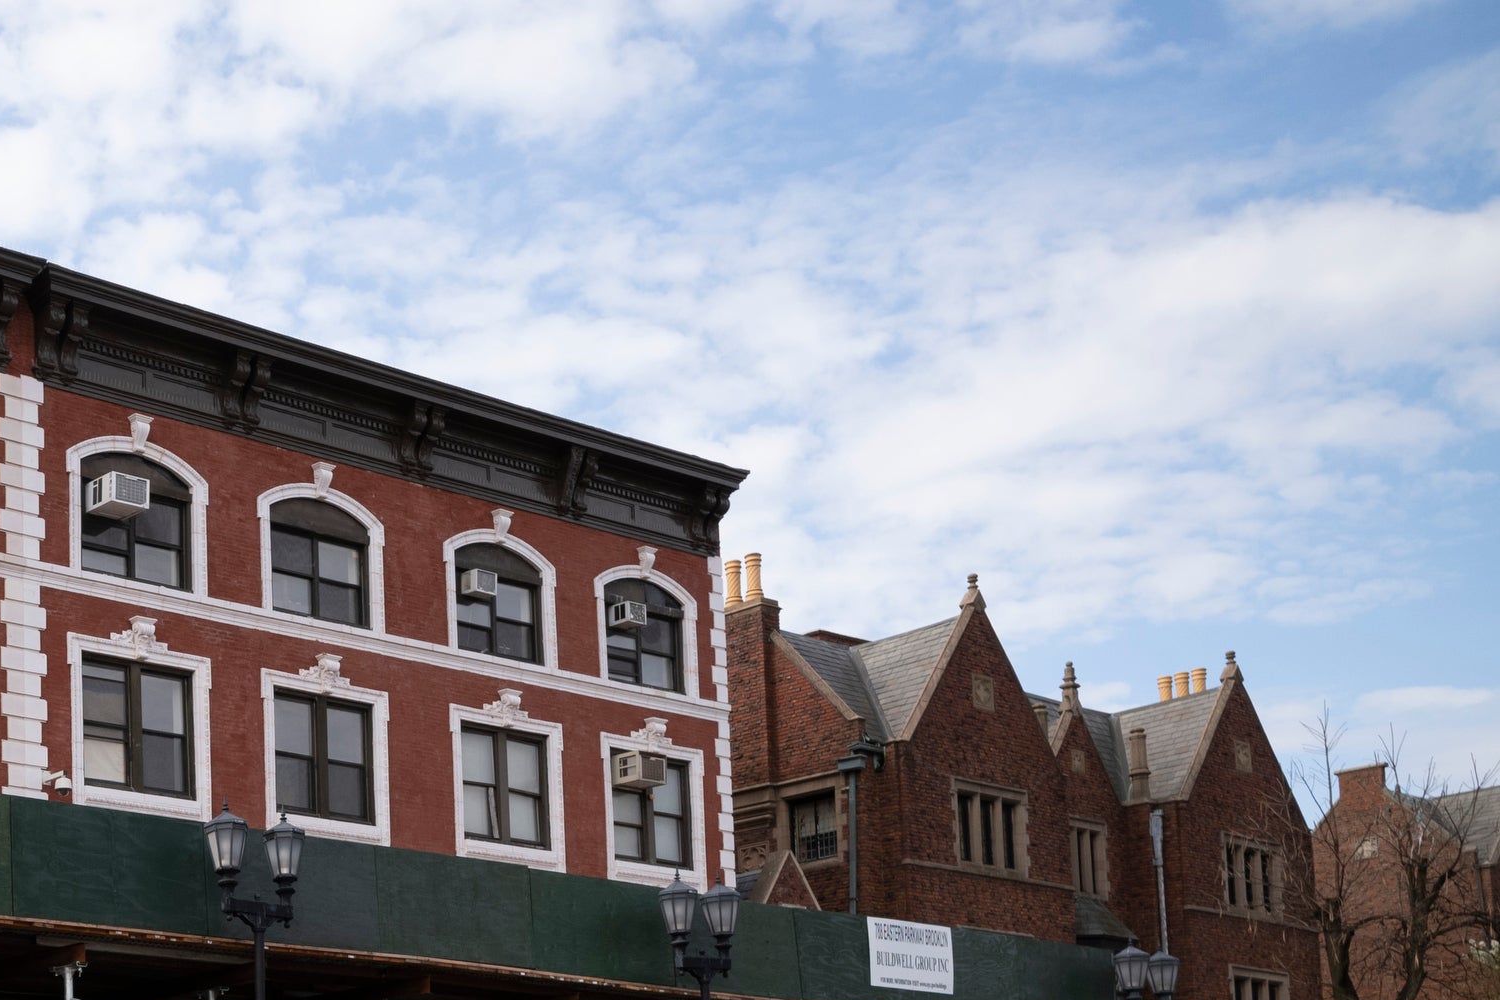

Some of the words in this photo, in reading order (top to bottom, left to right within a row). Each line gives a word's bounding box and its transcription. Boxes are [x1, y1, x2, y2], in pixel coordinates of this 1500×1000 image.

[884, 923, 905, 942] EASTERN
[905, 926, 925, 944] PARKWAY
[925, 929, 949, 947] BROOKLYN
[876, 951, 914, 969] BUILDWELL
[915, 955, 937, 972] GROUP
[937, 958, 949, 973] INC
